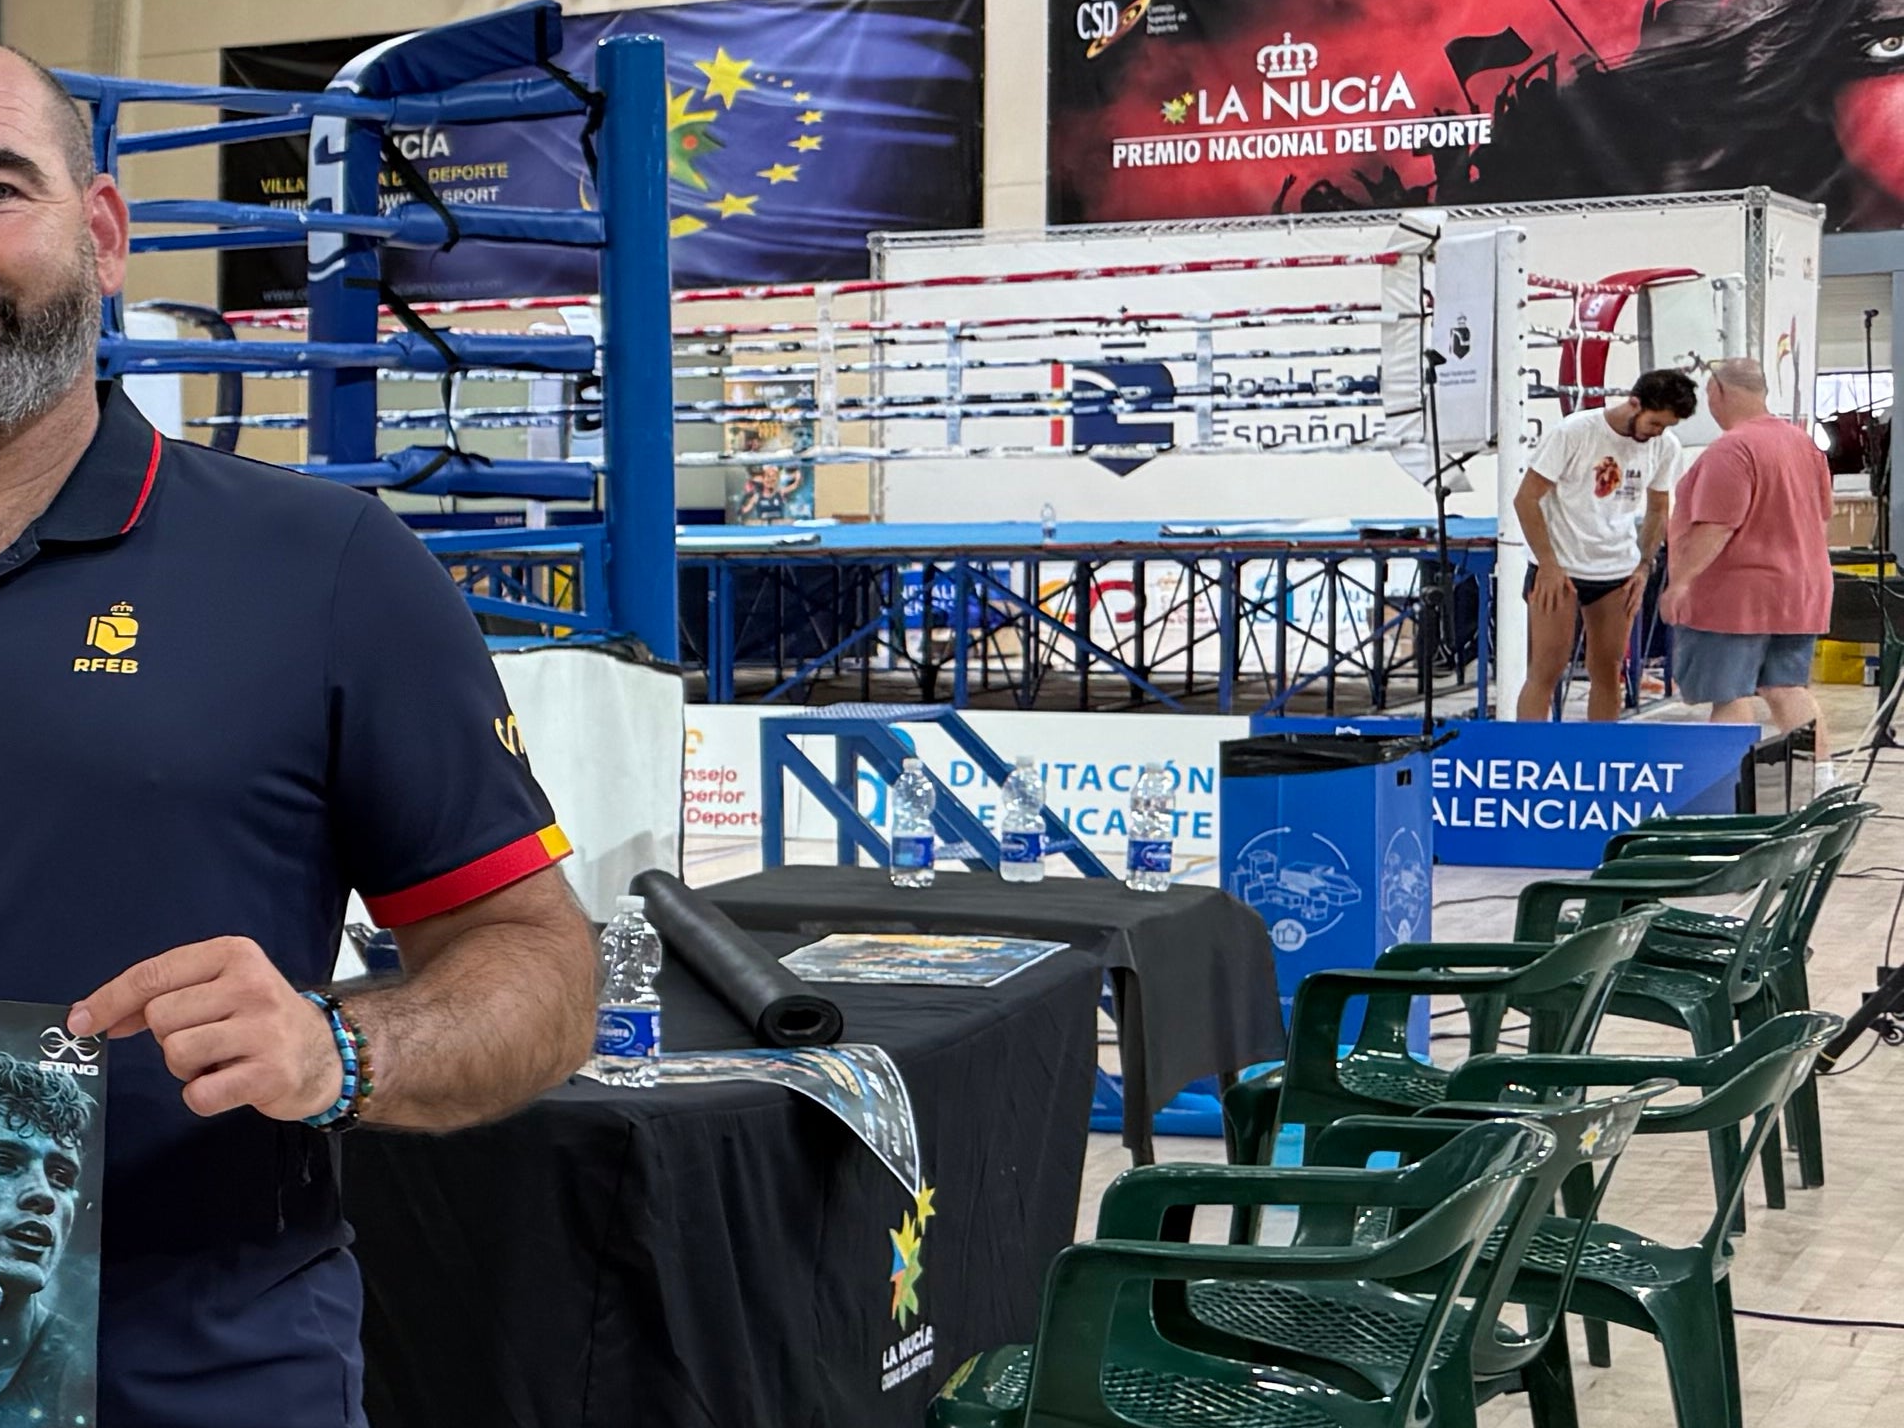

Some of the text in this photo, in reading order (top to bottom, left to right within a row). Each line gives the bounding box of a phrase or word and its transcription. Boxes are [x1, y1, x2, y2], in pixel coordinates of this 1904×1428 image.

[1077, 0, 1118, 40] CSD
[1198, 85, 1249, 125] LA
[1112, 119, 1491, 169] PREMIO NACIONAL DEL DEPORTE
[428, 162, 508, 182] DEPORTE
[444, 186, 500, 205] SPORT
[73, 658, 138, 675] RFEB
[1431, 758, 1684, 794] ENERALITAT
[39, 1060, 99, 1076] STING
